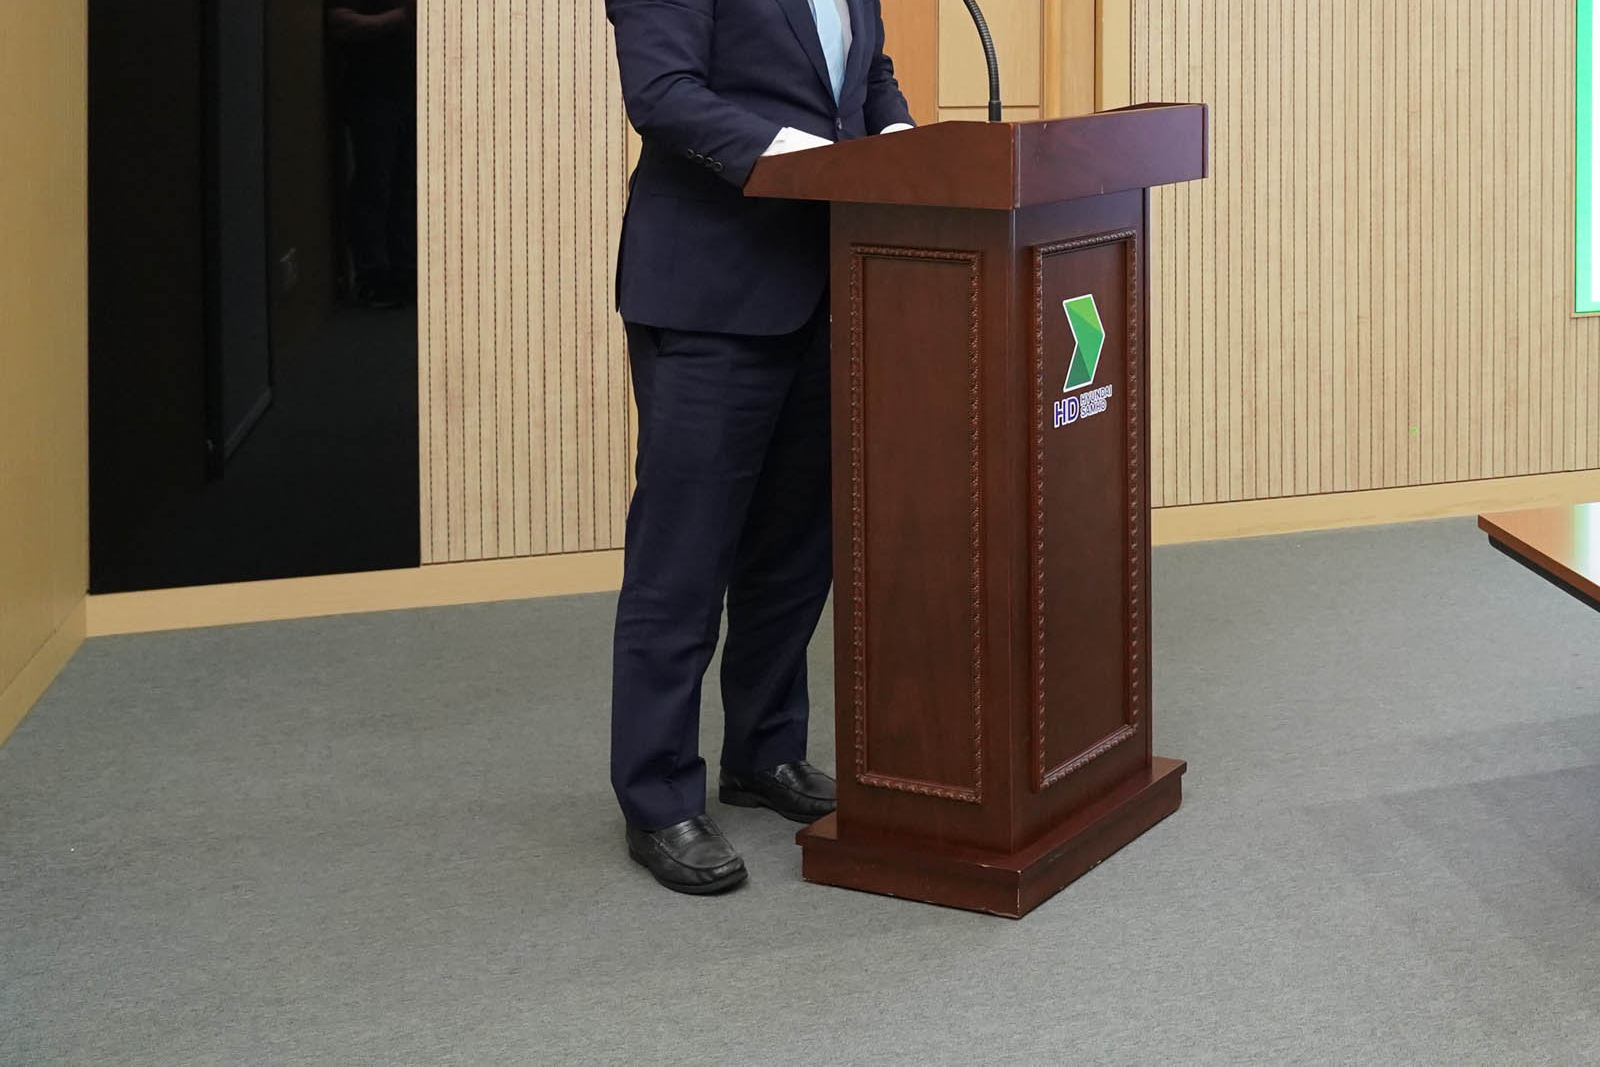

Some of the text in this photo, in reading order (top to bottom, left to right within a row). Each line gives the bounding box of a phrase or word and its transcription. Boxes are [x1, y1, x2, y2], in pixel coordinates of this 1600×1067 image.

[1054, 385, 1113, 428] HD HYUNDAI
[1080, 398, 1107, 418] SAMHO
